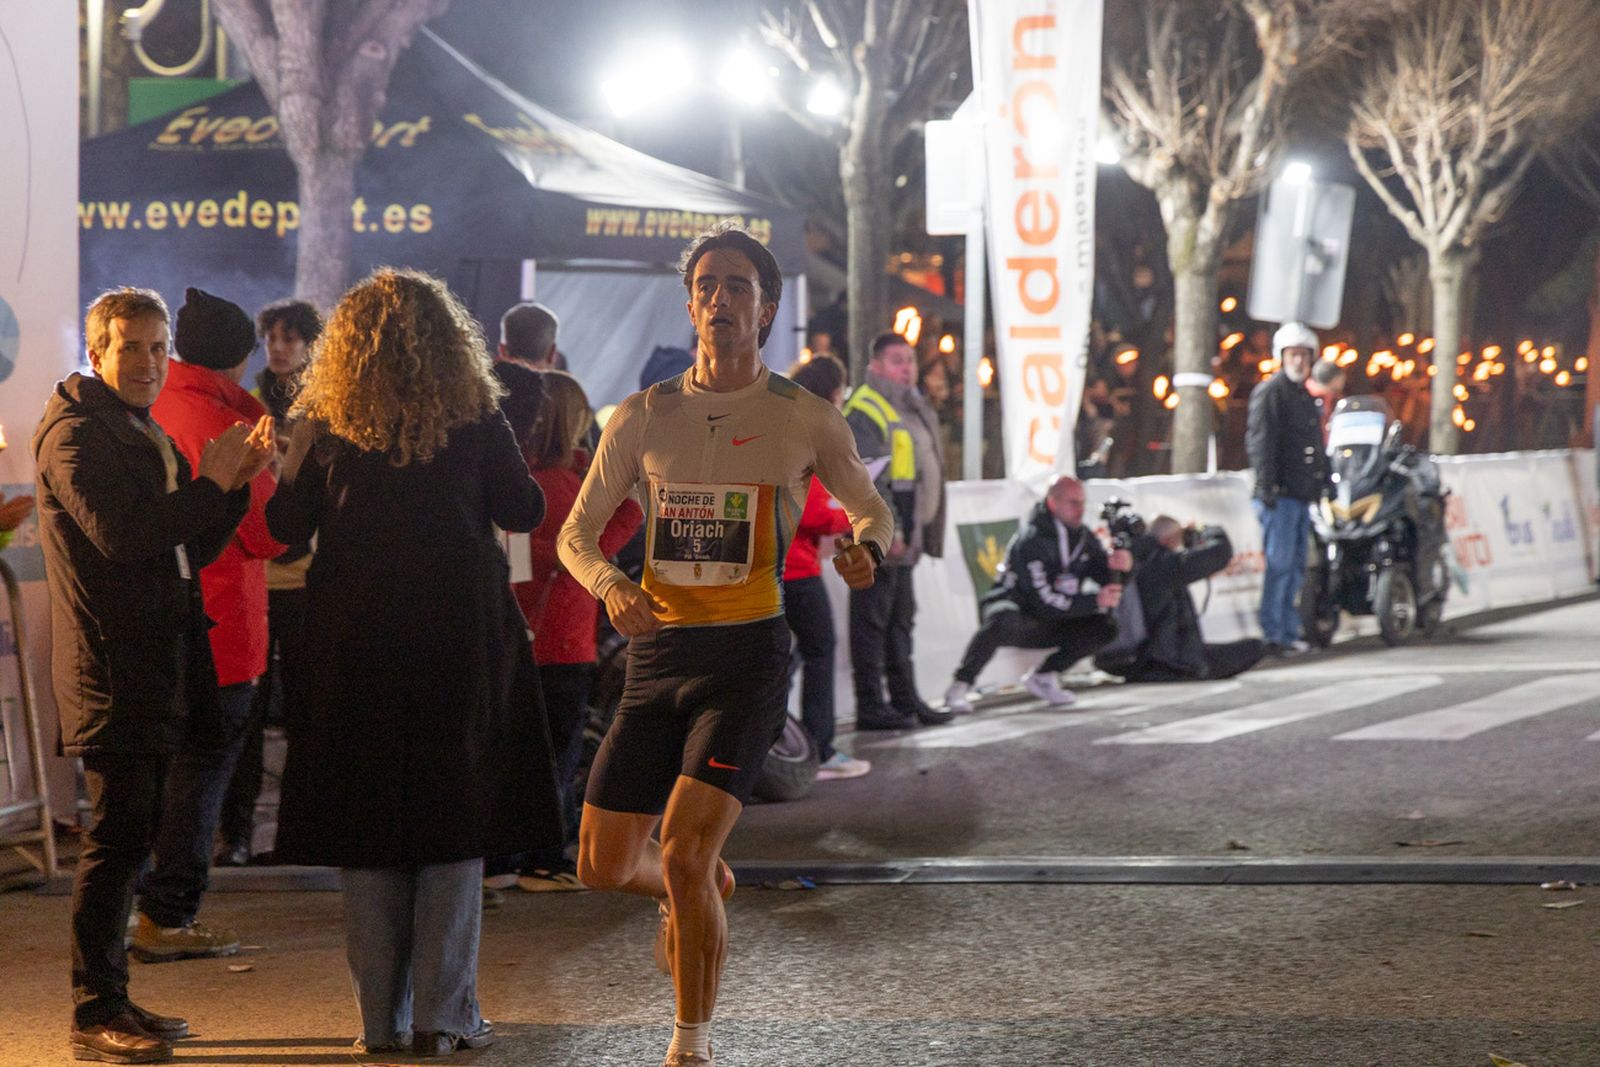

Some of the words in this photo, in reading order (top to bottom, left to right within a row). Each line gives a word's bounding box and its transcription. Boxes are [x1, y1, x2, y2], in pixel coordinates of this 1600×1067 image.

[668, 495, 701, 505] NOCHE
[702, 496, 715, 506] DE
[678, 505, 715, 519] ANTÓN
[670, 519, 725, 538] Oriach
[693, 538, 701, 553] 5
